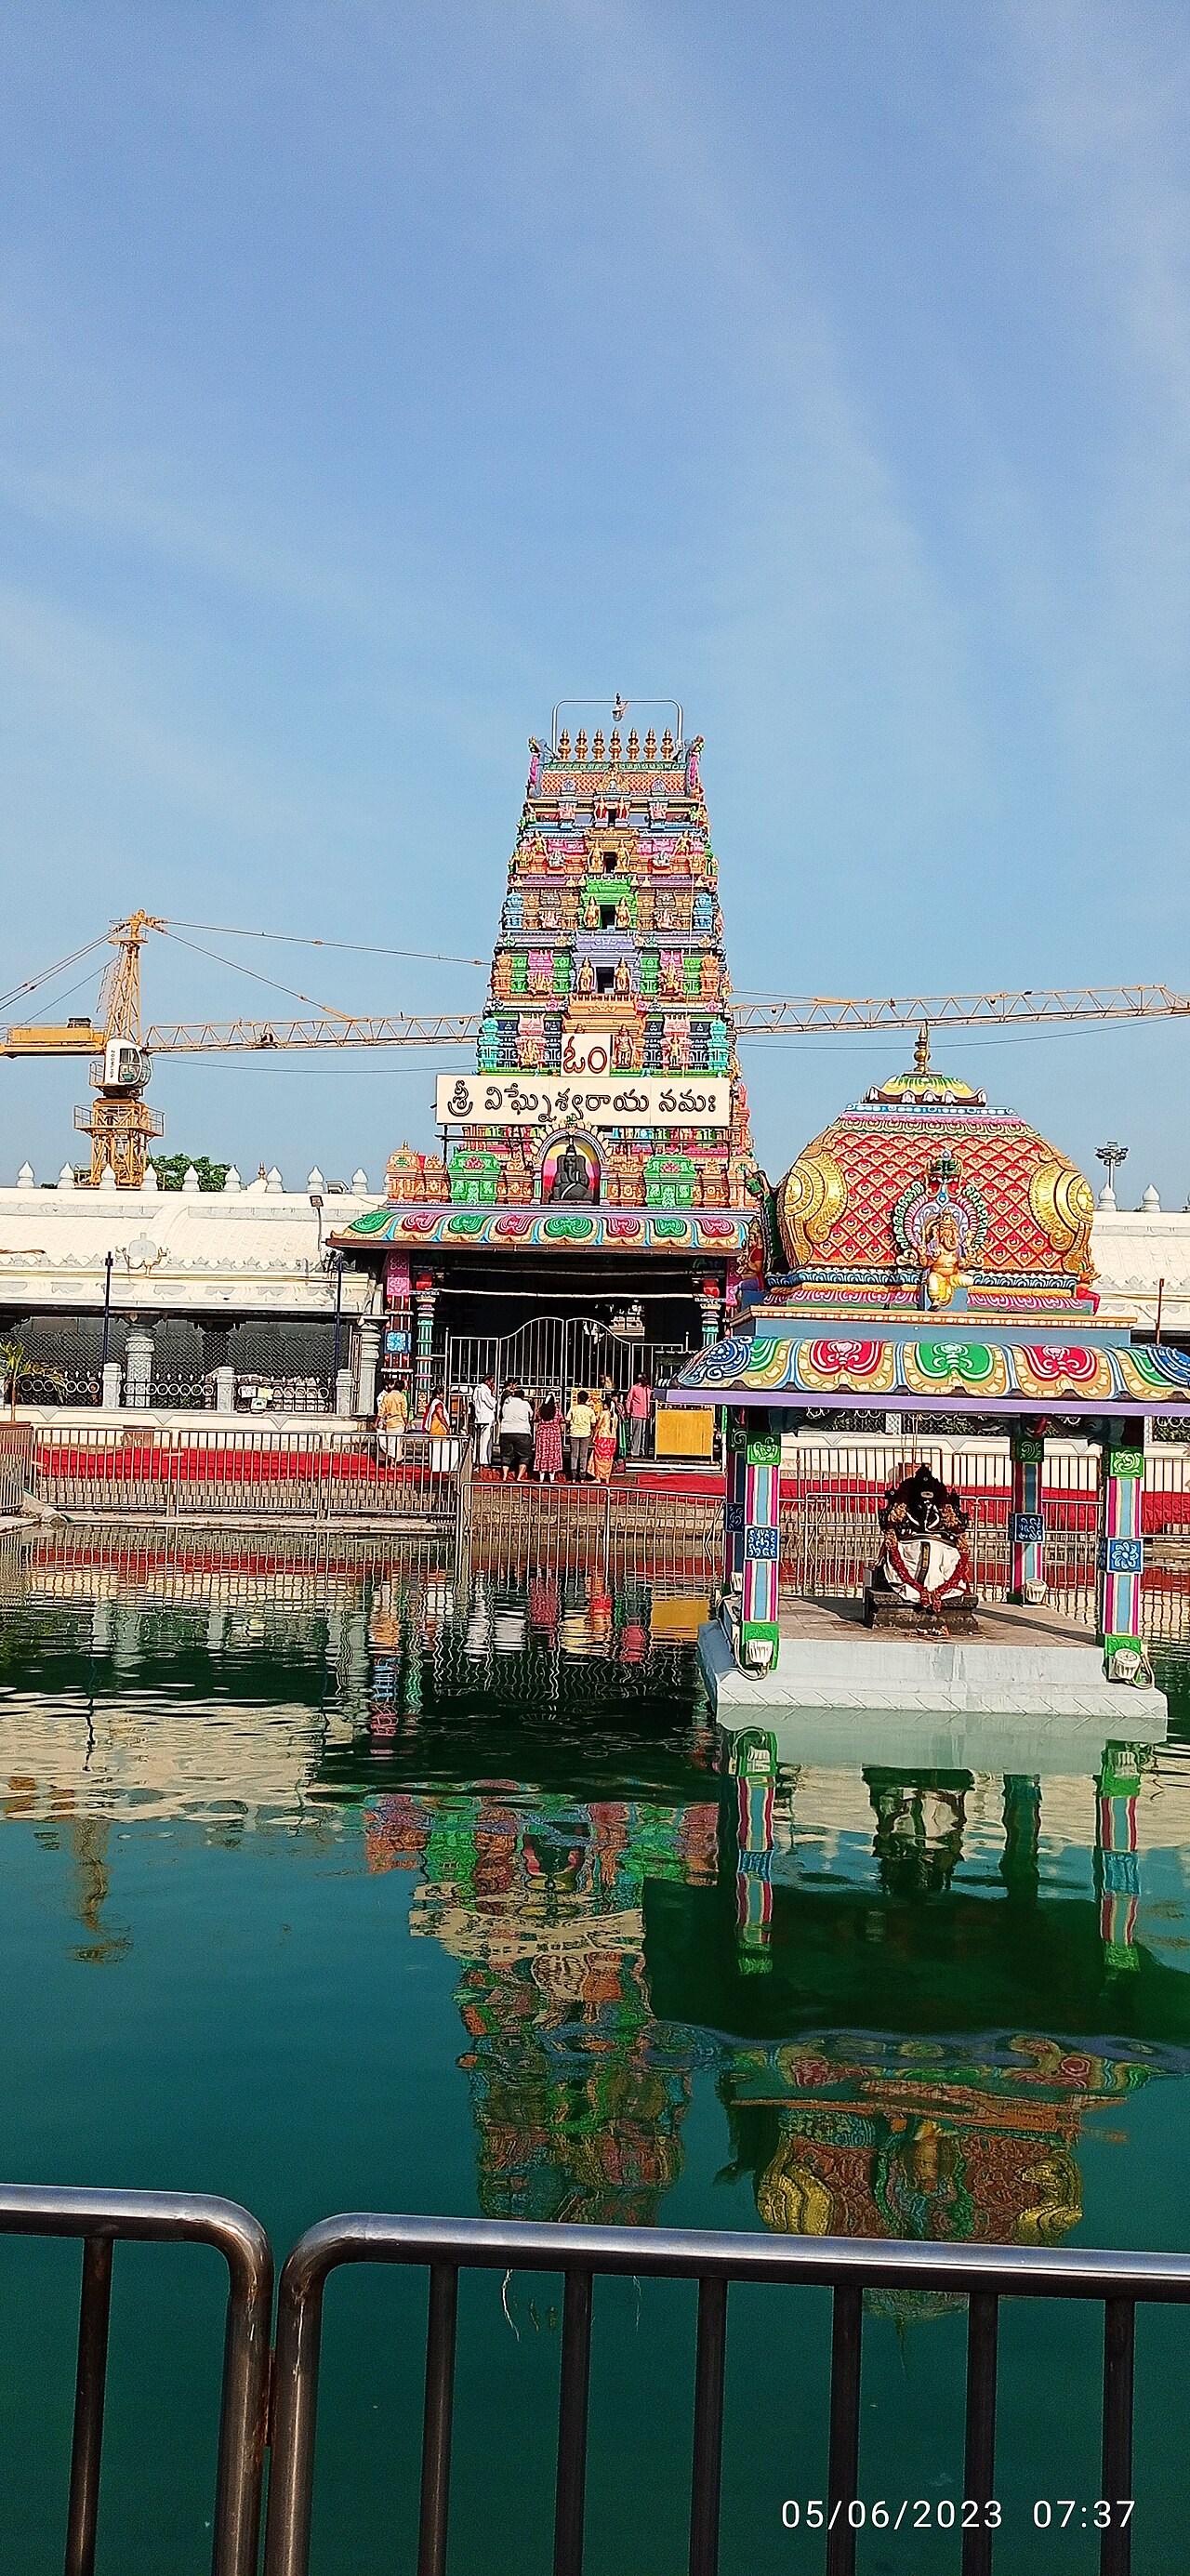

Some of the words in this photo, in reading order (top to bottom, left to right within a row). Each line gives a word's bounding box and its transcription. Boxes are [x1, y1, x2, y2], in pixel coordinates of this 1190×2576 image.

[562, 1035, 607, 1074] ఓం
[447, 1079, 473, 1116] శ్రీ
[484, 1082, 649, 1122] విఘ్నేశ్వరాయ
[658, 1088, 717, 1113] నమః
